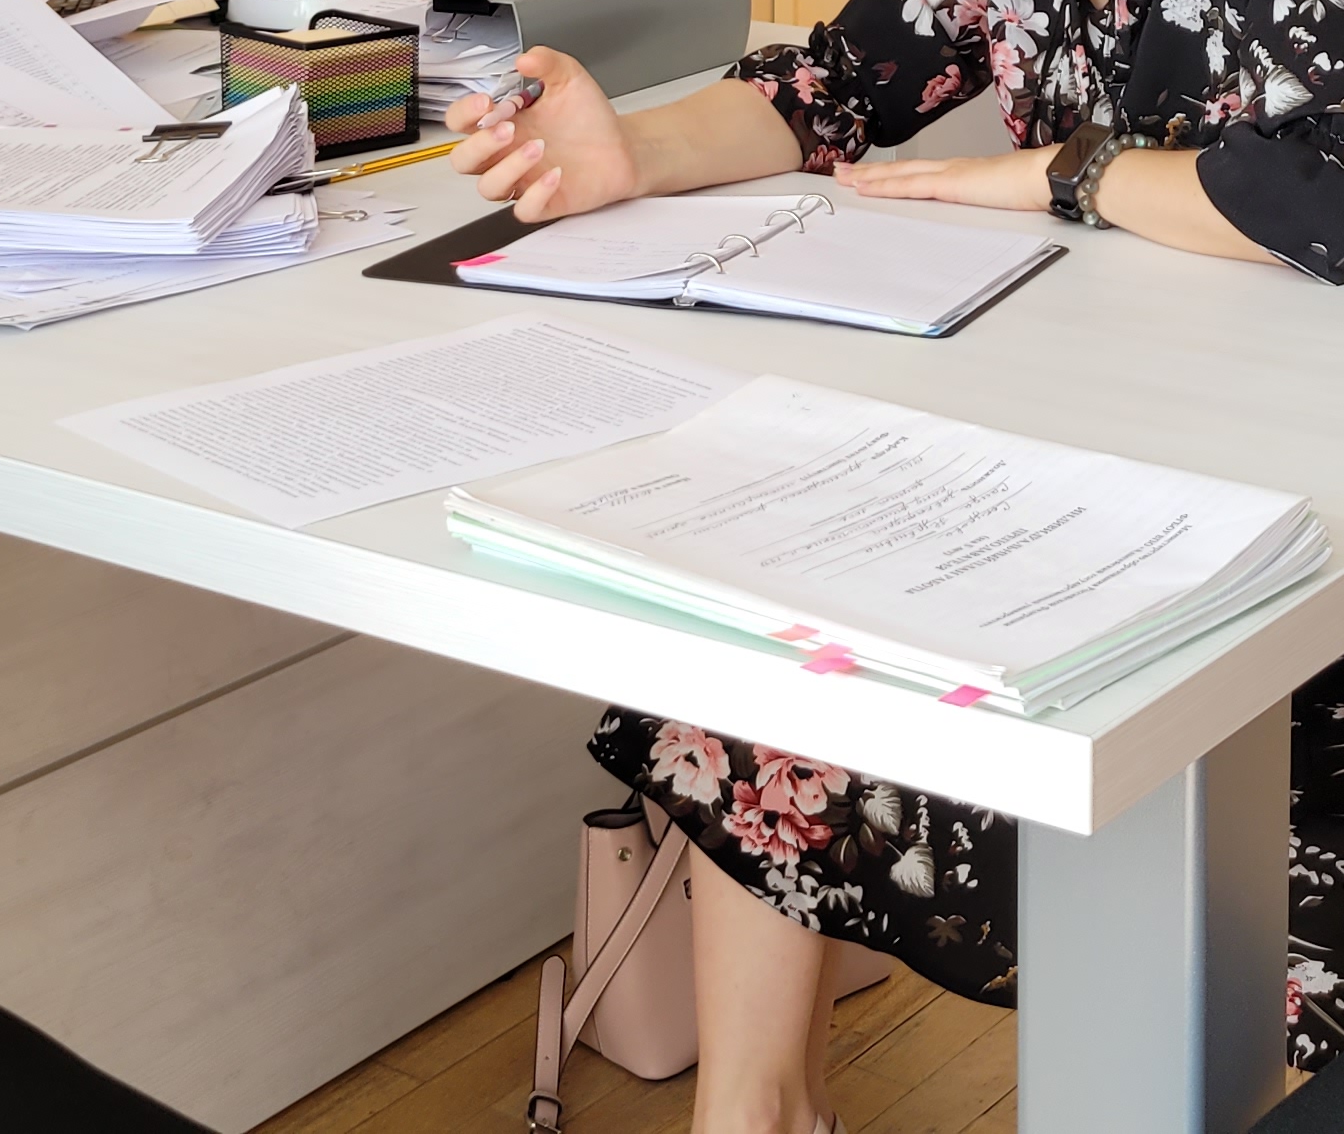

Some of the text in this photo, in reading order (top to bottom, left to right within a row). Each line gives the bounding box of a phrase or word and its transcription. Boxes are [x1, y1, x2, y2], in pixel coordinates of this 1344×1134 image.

[1158, 512, 1192, 534] ФГБОУ
[901, 505, 1089, 595] ИНДИВИДУАЛЬНЫЙ ПЛАН РАБОТЫ
[932, 527, 1031, 570] ПРЕПОДАВАТЕЛЯ
[1140, 533, 1166, 547] ВПО
